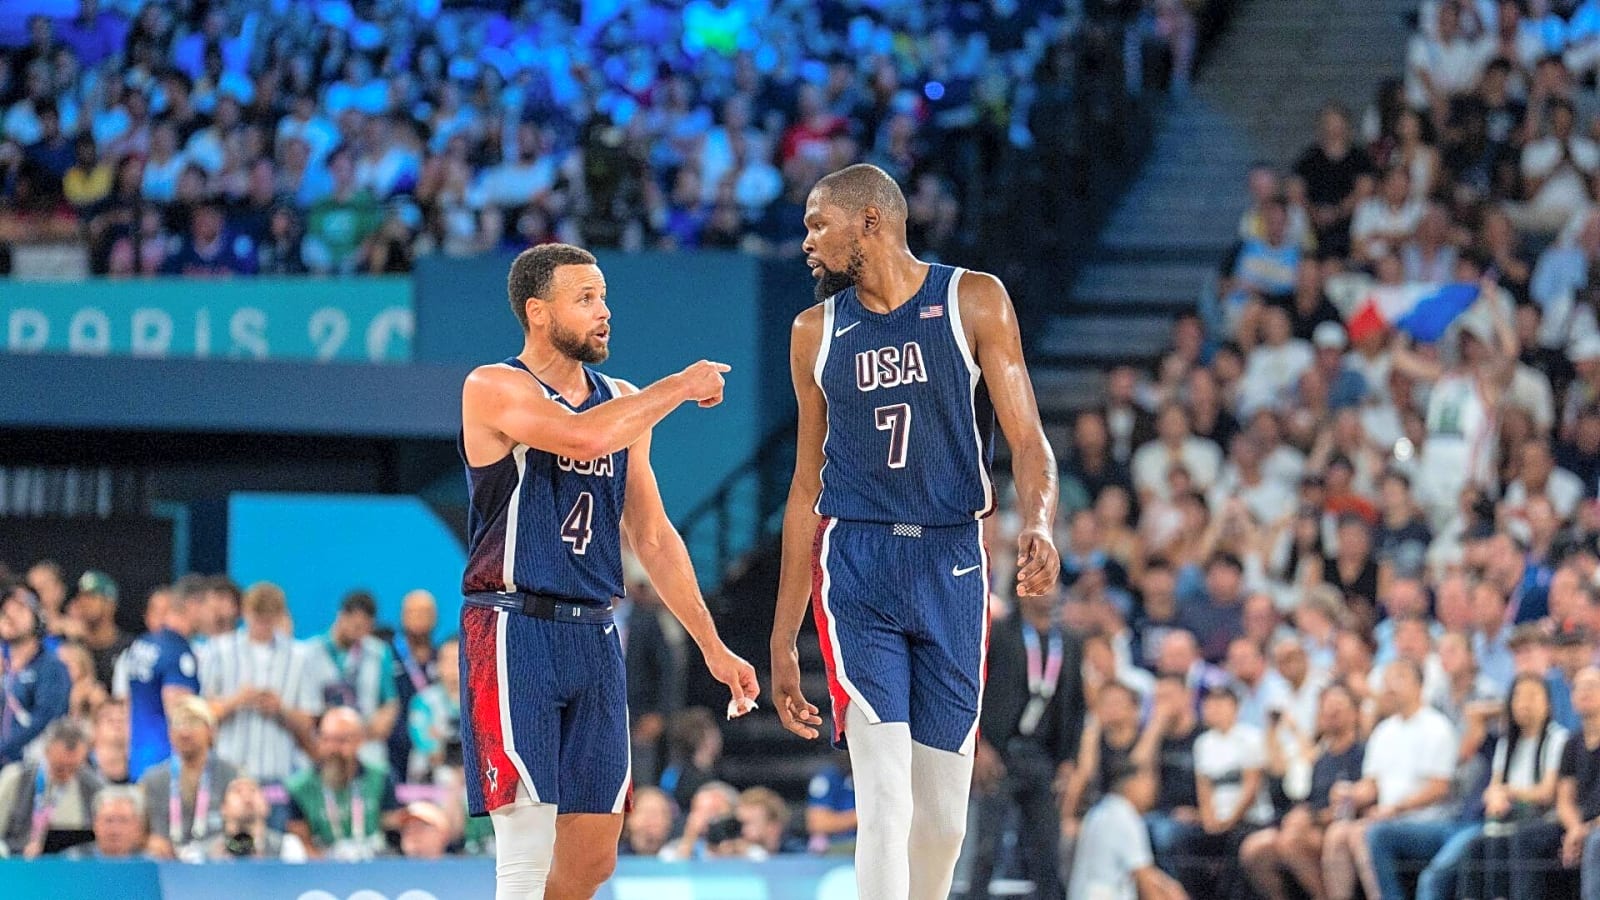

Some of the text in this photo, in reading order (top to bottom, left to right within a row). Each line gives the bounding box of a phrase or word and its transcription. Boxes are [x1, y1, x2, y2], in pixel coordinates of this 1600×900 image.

[7, 306, 270, 359] PARIS
[855, 341, 928, 392] USA
[875, 402, 911, 469] 7
[560, 491, 594, 555] 4
